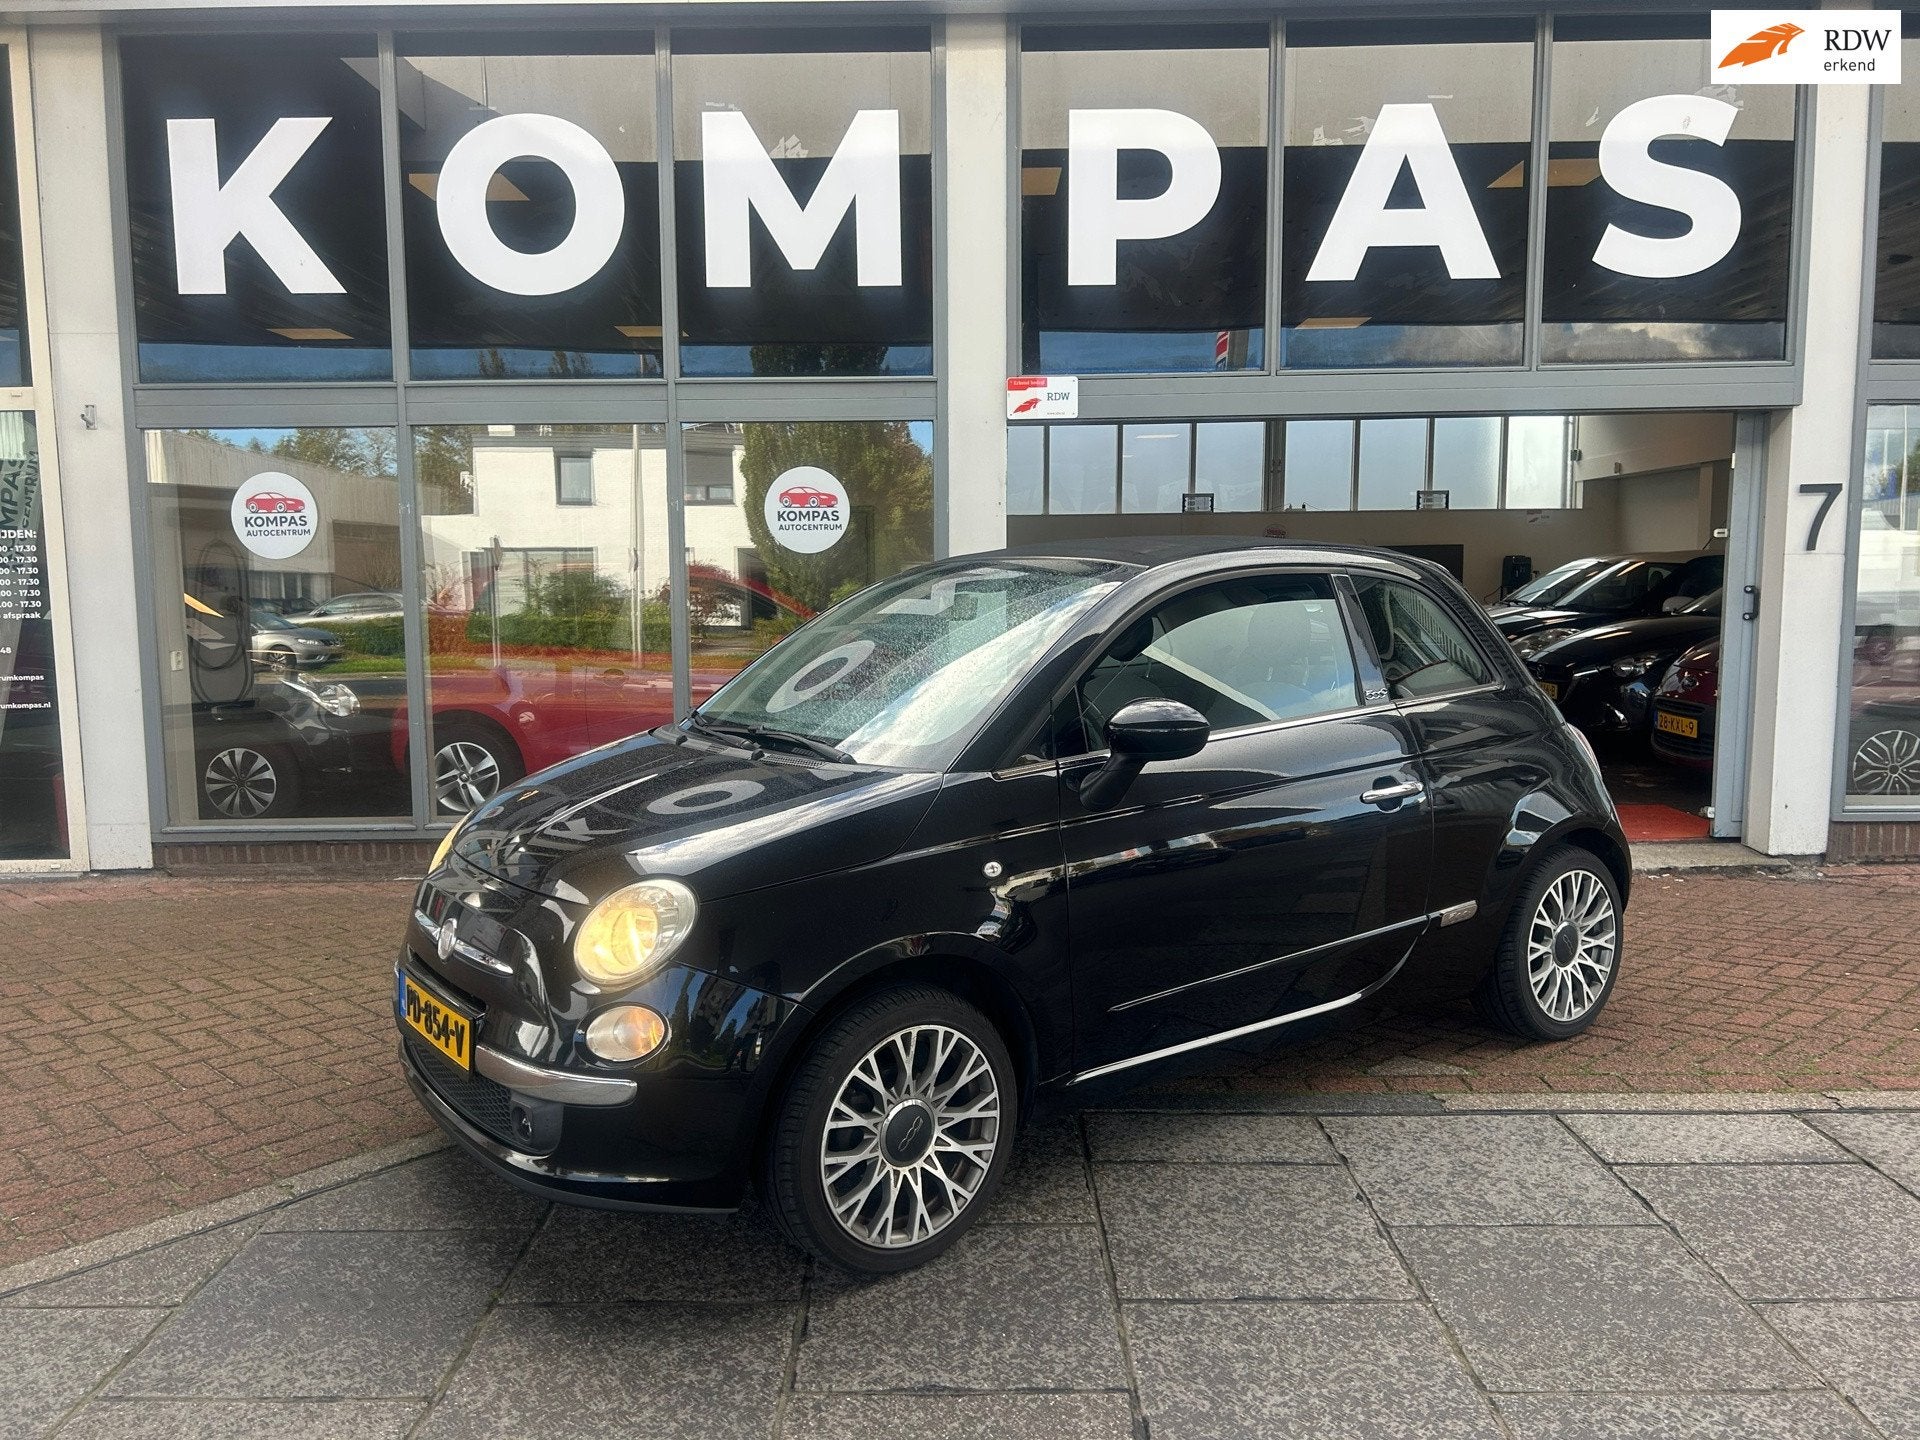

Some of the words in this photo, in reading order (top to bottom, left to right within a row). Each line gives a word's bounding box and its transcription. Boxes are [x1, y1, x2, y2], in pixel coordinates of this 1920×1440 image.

[166, 95, 1742, 297] KOMPAS
[1046, 392, 1071, 401] RDW
[777, 510, 840, 522] KOMPAS
[1799, 483, 1843, 552] 7
[244, 515, 308, 528] KOMPAS
[778, 523, 843, 531] AUTOCENTRUM
[0, 529, 37, 539] JDEN:
[246, 528, 311, 537] AUTOCENTRUM
[19, 589, 41, 597] 17.30
[3, 611, 41, 620] afspraak
[1659, 714, 1695, 735] 28-KXL-9
